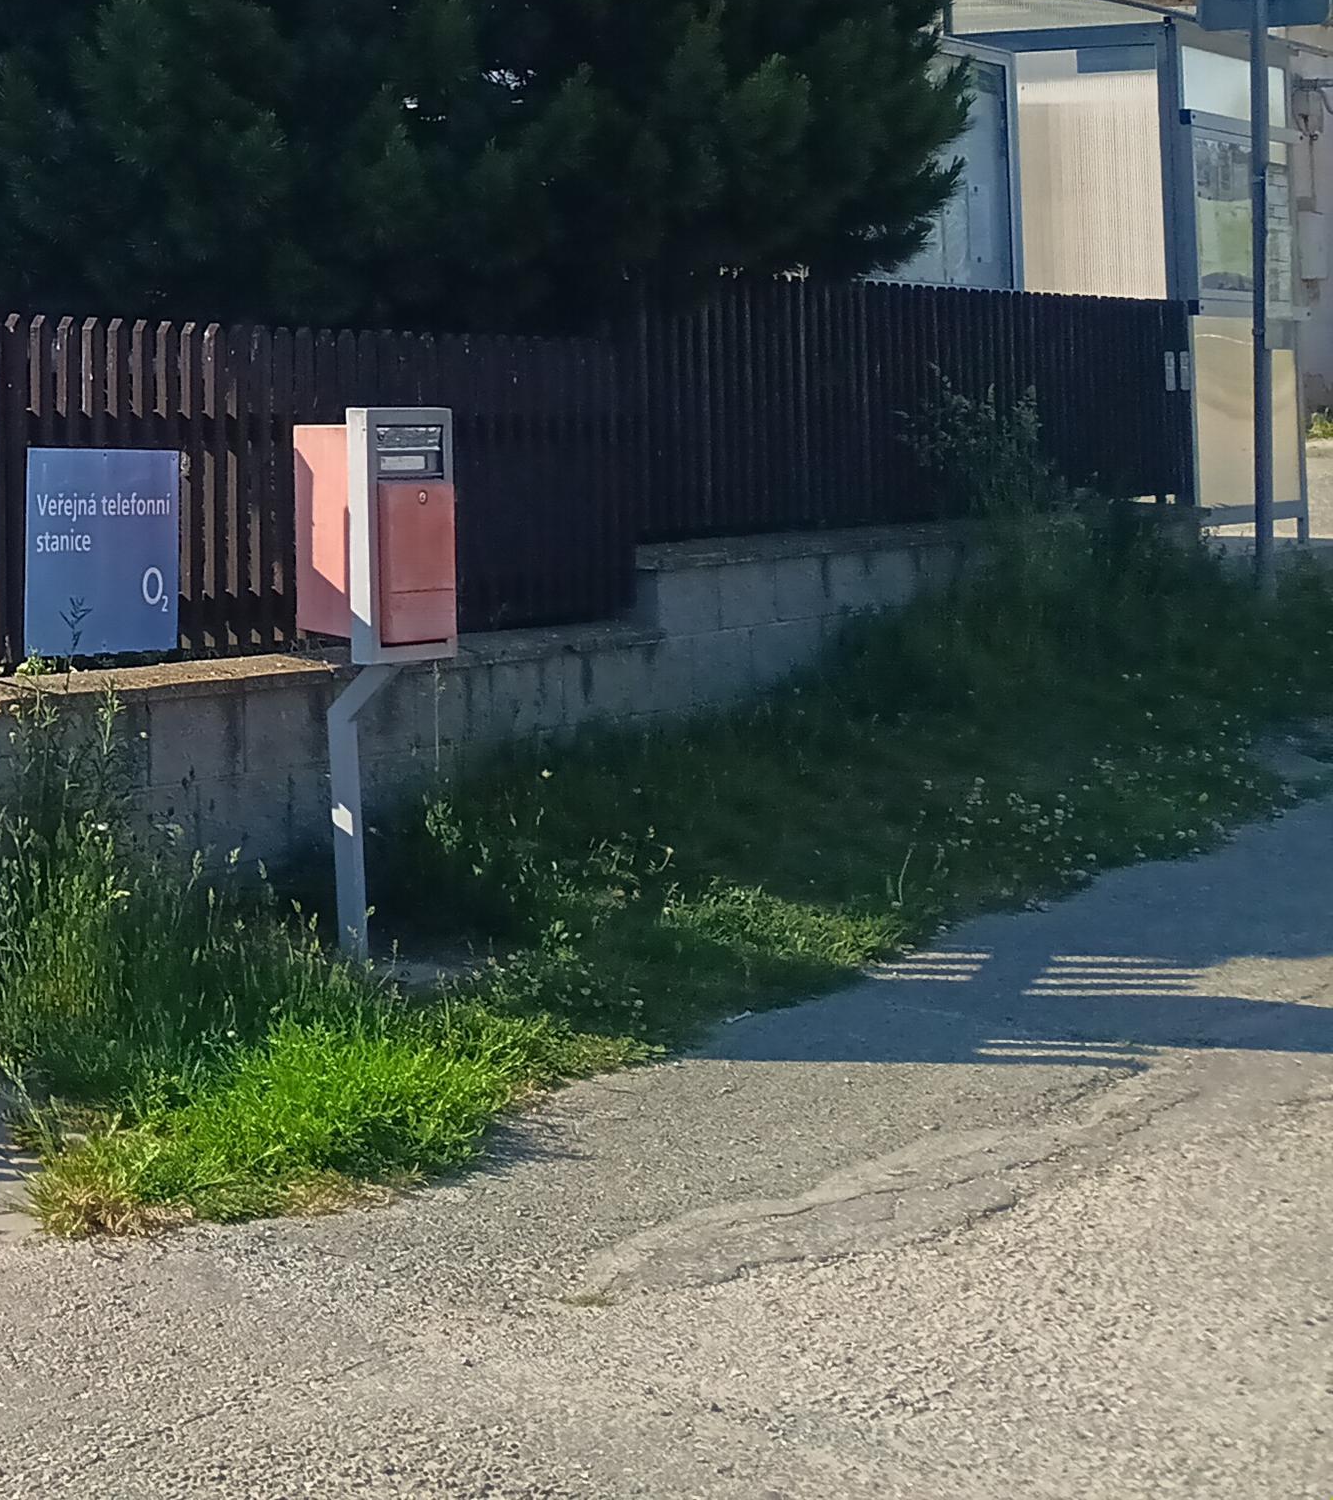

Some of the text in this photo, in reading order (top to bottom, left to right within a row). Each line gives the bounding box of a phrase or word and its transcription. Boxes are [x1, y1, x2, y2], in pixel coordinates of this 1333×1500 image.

[37, 492, 171, 522] Veřejná telefonní
[36, 528, 92, 553] stanice
